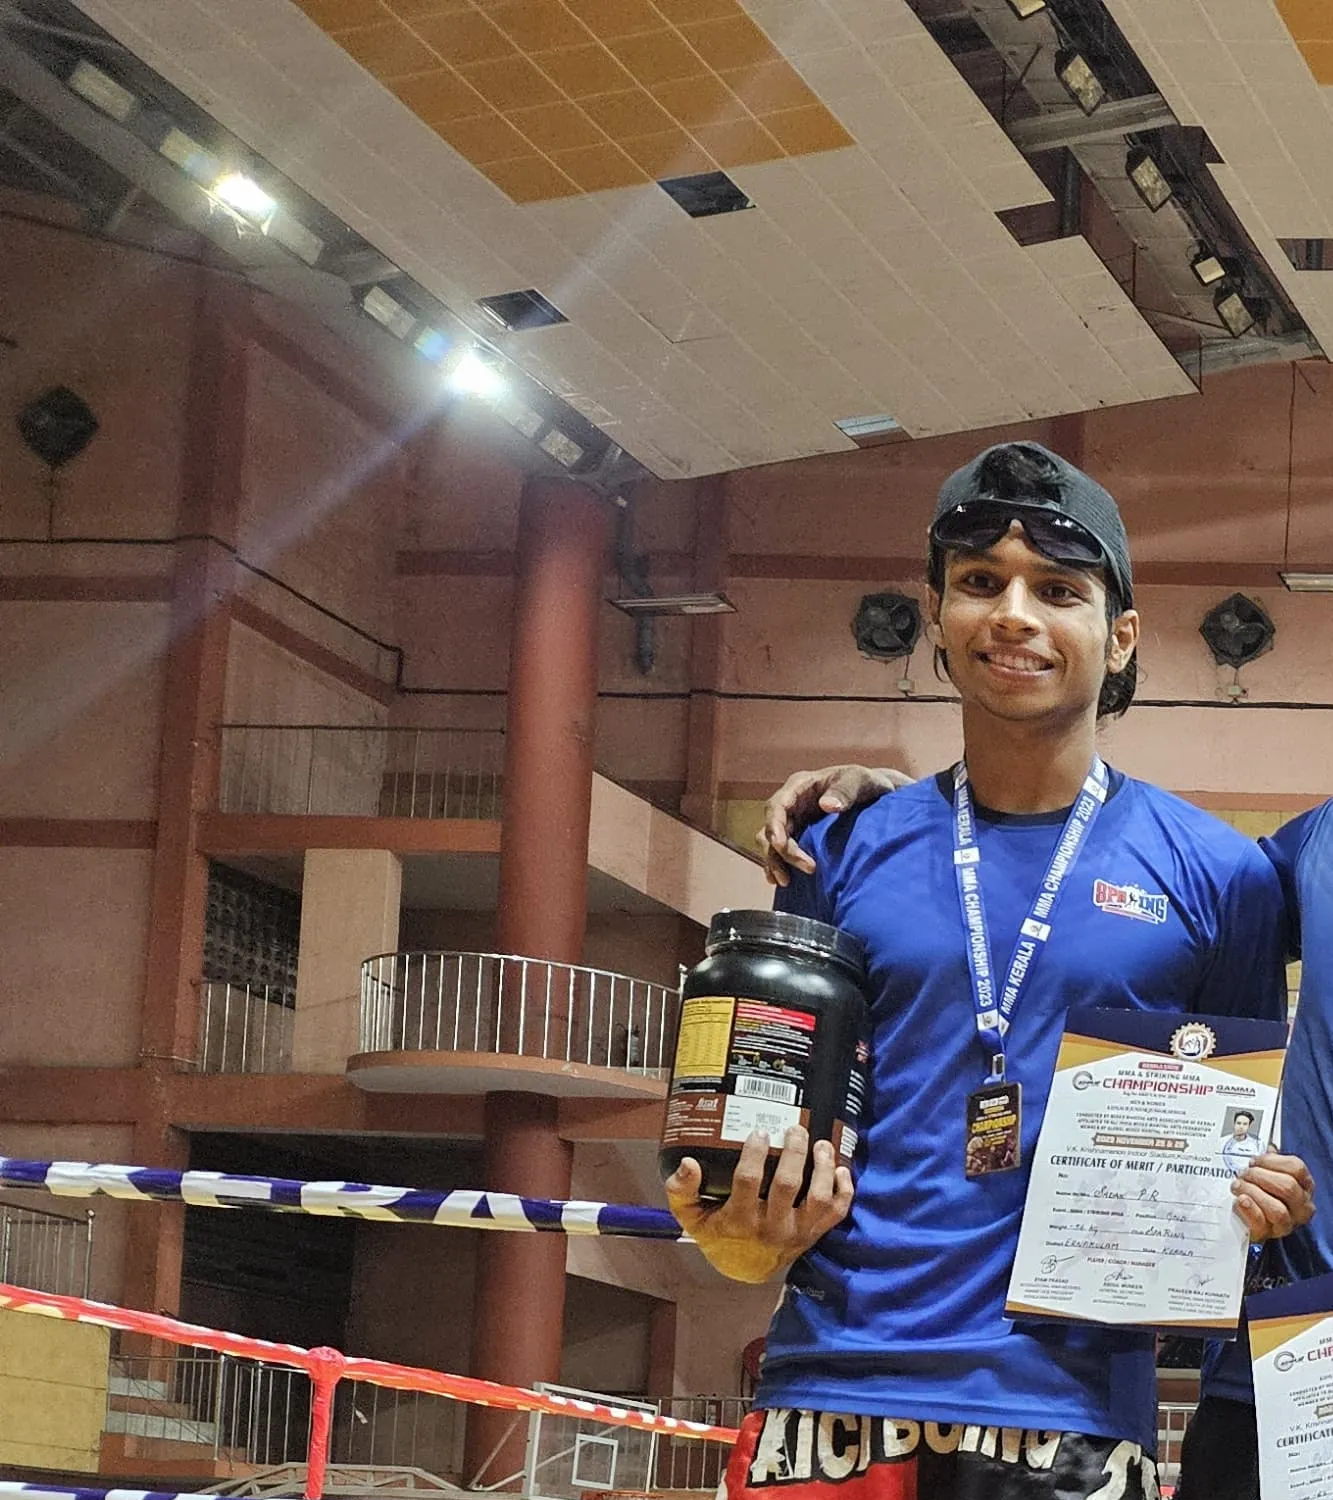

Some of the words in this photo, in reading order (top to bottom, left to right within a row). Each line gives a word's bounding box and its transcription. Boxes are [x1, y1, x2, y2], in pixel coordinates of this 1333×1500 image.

[1075, 797, 1096, 822] 2023
[1043, 818, 1086, 893] CHAMPIONSHIP
[962, 867, 978, 893] MMA
[1033, 890, 1055, 919] MMA
[964, 893, 989, 978] CHAMPIONSHIP
[1008, 940, 1036, 985] KERALA
[976, 977, 992, 1008] 2023
[1001, 981, 1019, 1014] MMA
[1101, 1076, 1214, 1096] CHAMPIONSHIP
[1117, 1068, 1136, 1077] MMA
[1137, 1070, 1144, 1078] &
[1144, 1070, 1180, 1080] STRIKING
[1181, 1073, 1201, 1082] MMA
[1049, 1153, 1111, 1169] CERTIFICATE
[1110, 1158, 1124, 1170] OF
[1126, 1159, 1155, 1173] MERIT
[1165, 1162, 1239, 1179] PARTICIPATION
